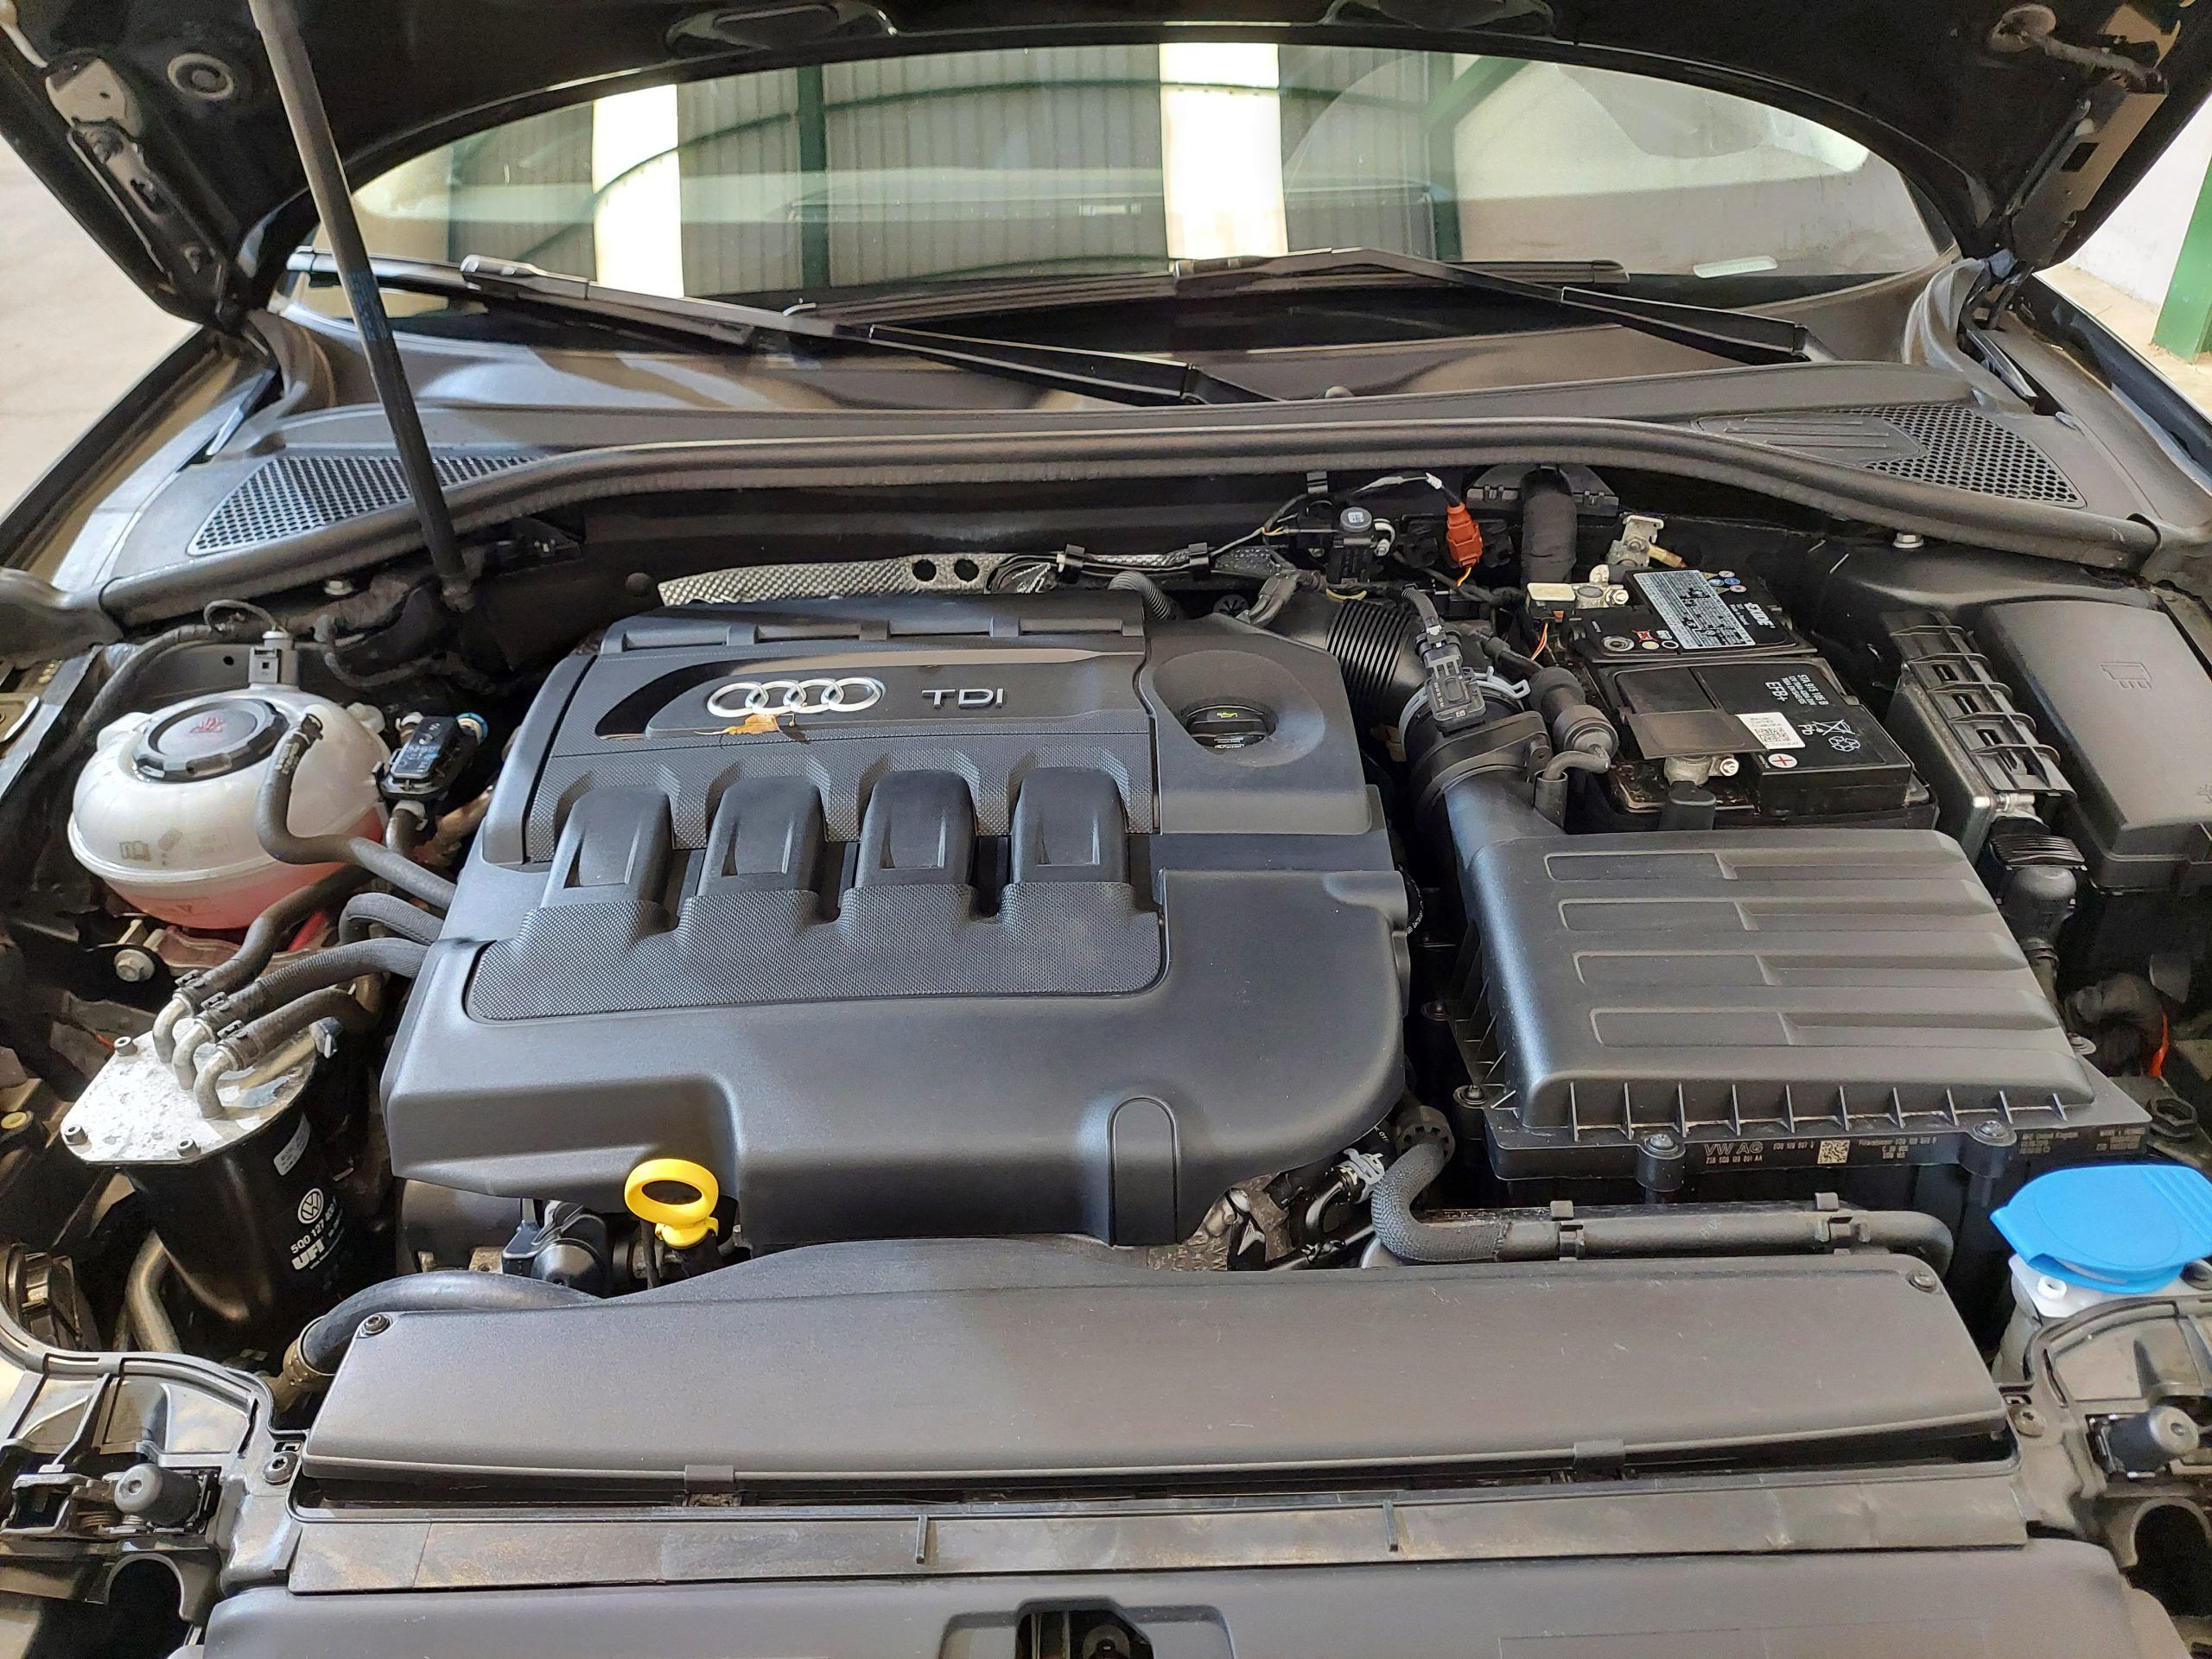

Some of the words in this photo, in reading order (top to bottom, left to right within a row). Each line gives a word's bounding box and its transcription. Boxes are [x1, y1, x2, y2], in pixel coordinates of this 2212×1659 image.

[1764, 681, 1789, 702] EFB+
[1804, 683, 1819, 692] 915
[921, 688, 1004, 708] TDI
[1797, 724, 1813, 735] Pb
[1704, 1141, 1734, 1156] VW
[1735, 1141, 1764, 1154] AG
[290, 1235, 311, 1254] 5Q0
[311, 1219, 324, 1237] 127
[291, 1238, 326, 1270] UFI
